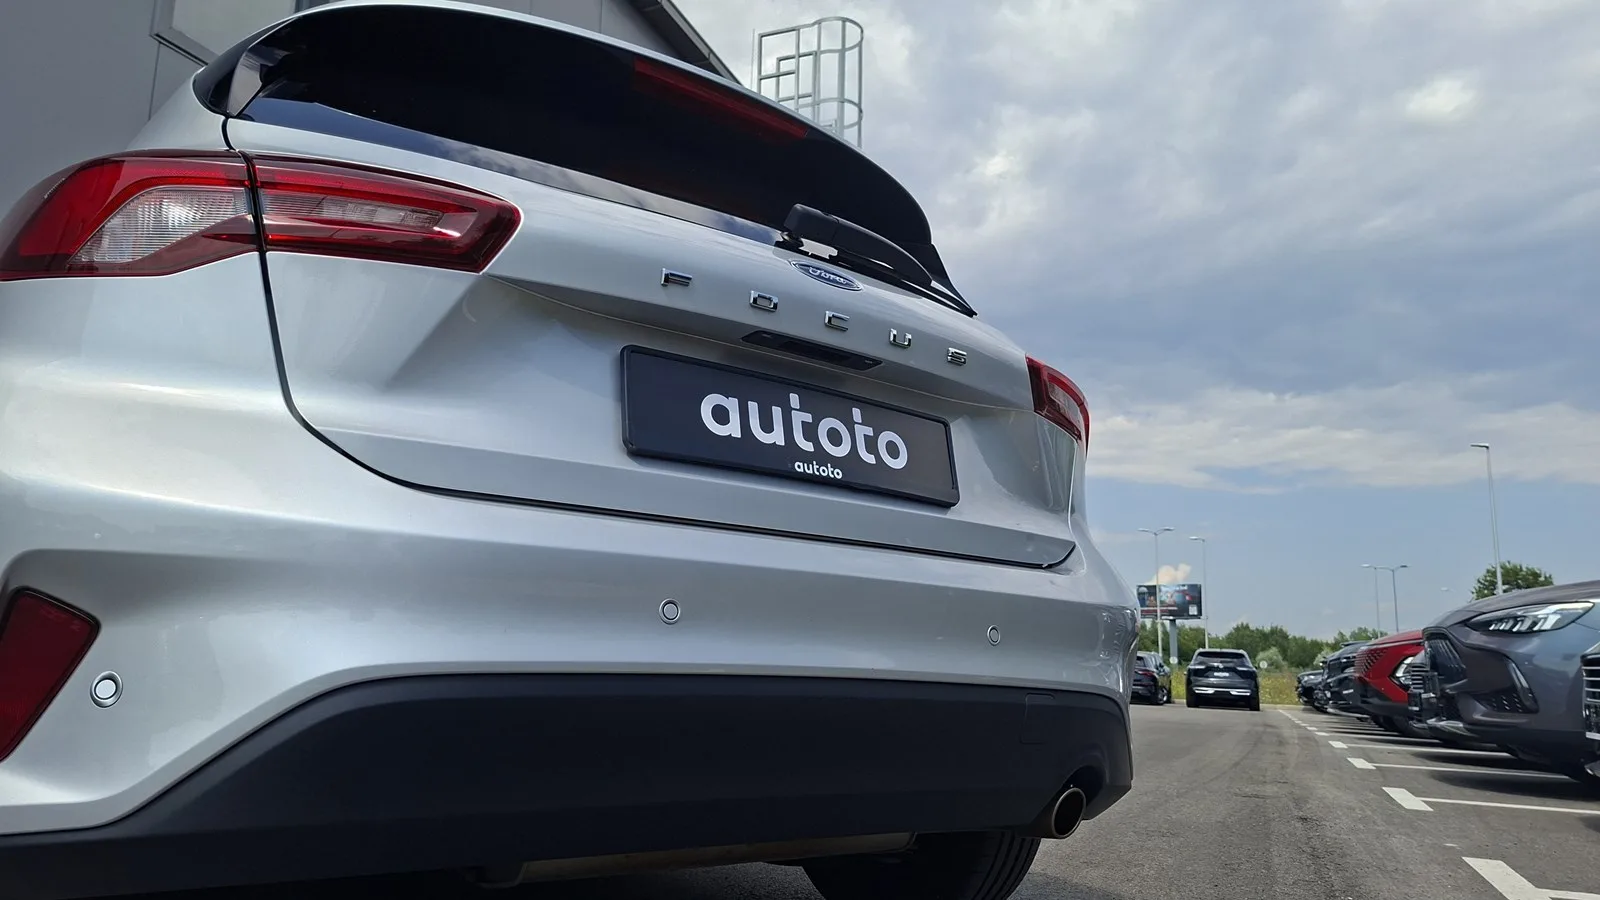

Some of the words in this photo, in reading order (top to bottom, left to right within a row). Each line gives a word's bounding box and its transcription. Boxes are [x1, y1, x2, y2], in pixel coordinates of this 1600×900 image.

[809, 267, 848, 284] Ford
[661, 268, 967, 365] FOCUS
[701, 393, 908, 469] autoto
[794, 460, 843, 479] autoto
